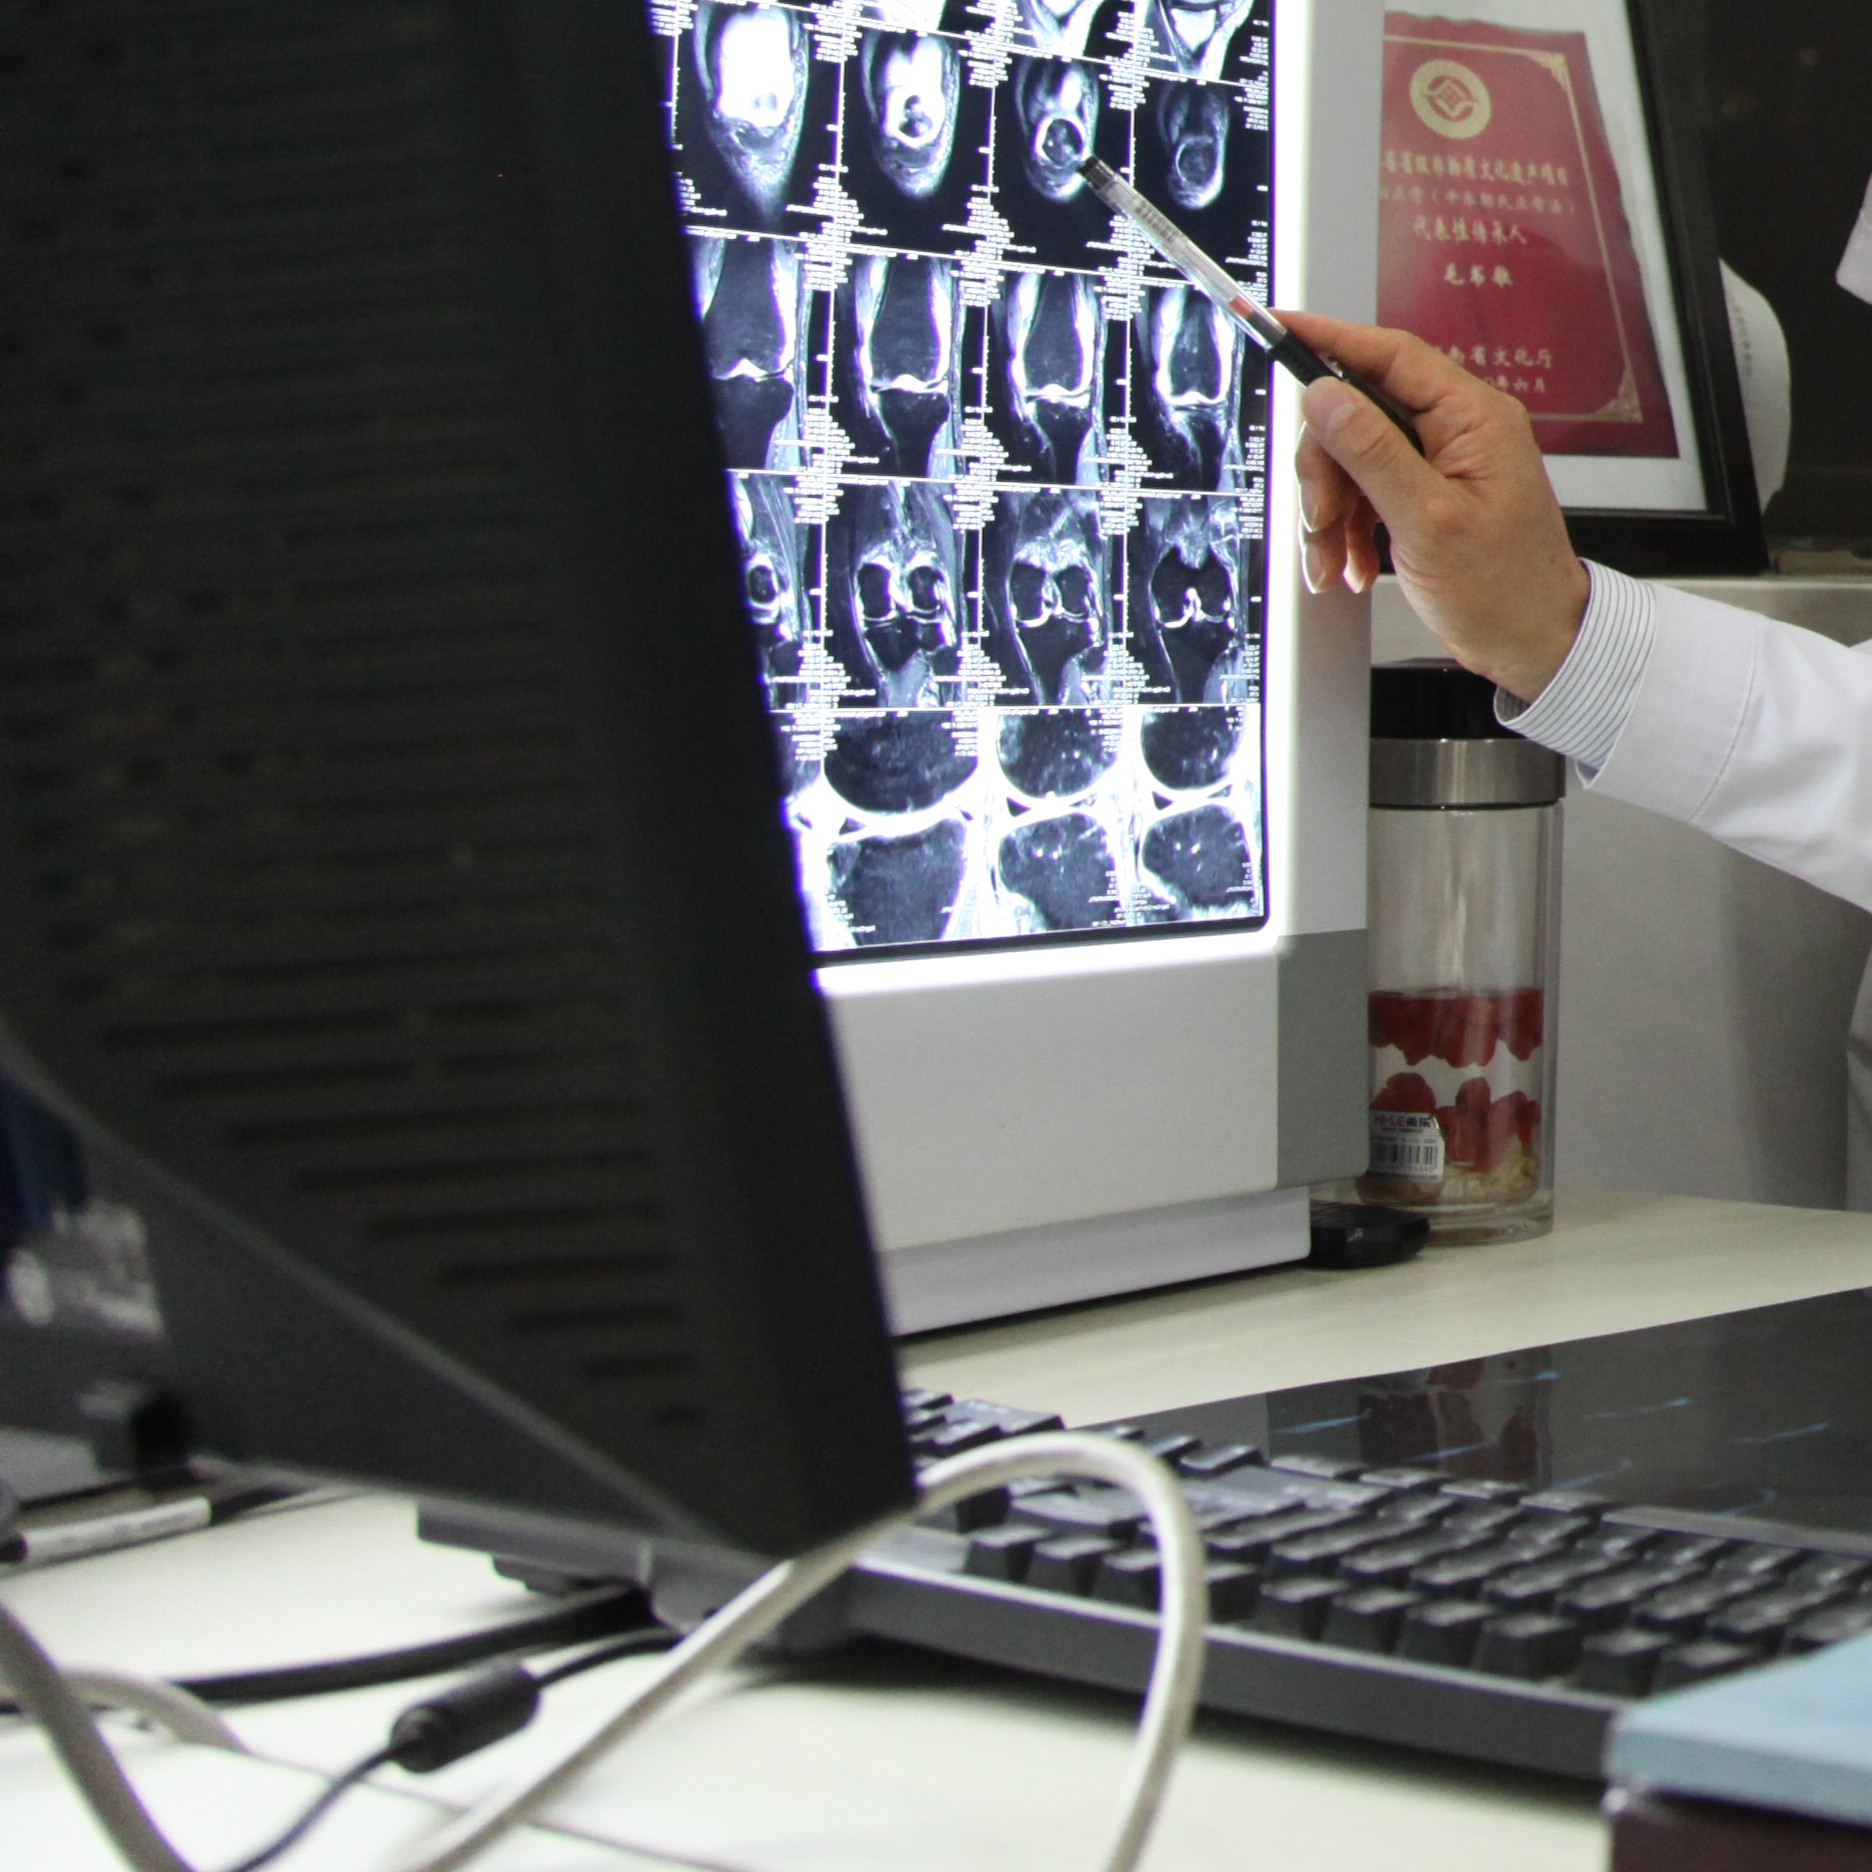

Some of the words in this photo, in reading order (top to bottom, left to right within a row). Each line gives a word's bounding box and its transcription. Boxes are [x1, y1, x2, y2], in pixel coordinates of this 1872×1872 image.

[1414, 214, 1528, 246] 代表性传承人
